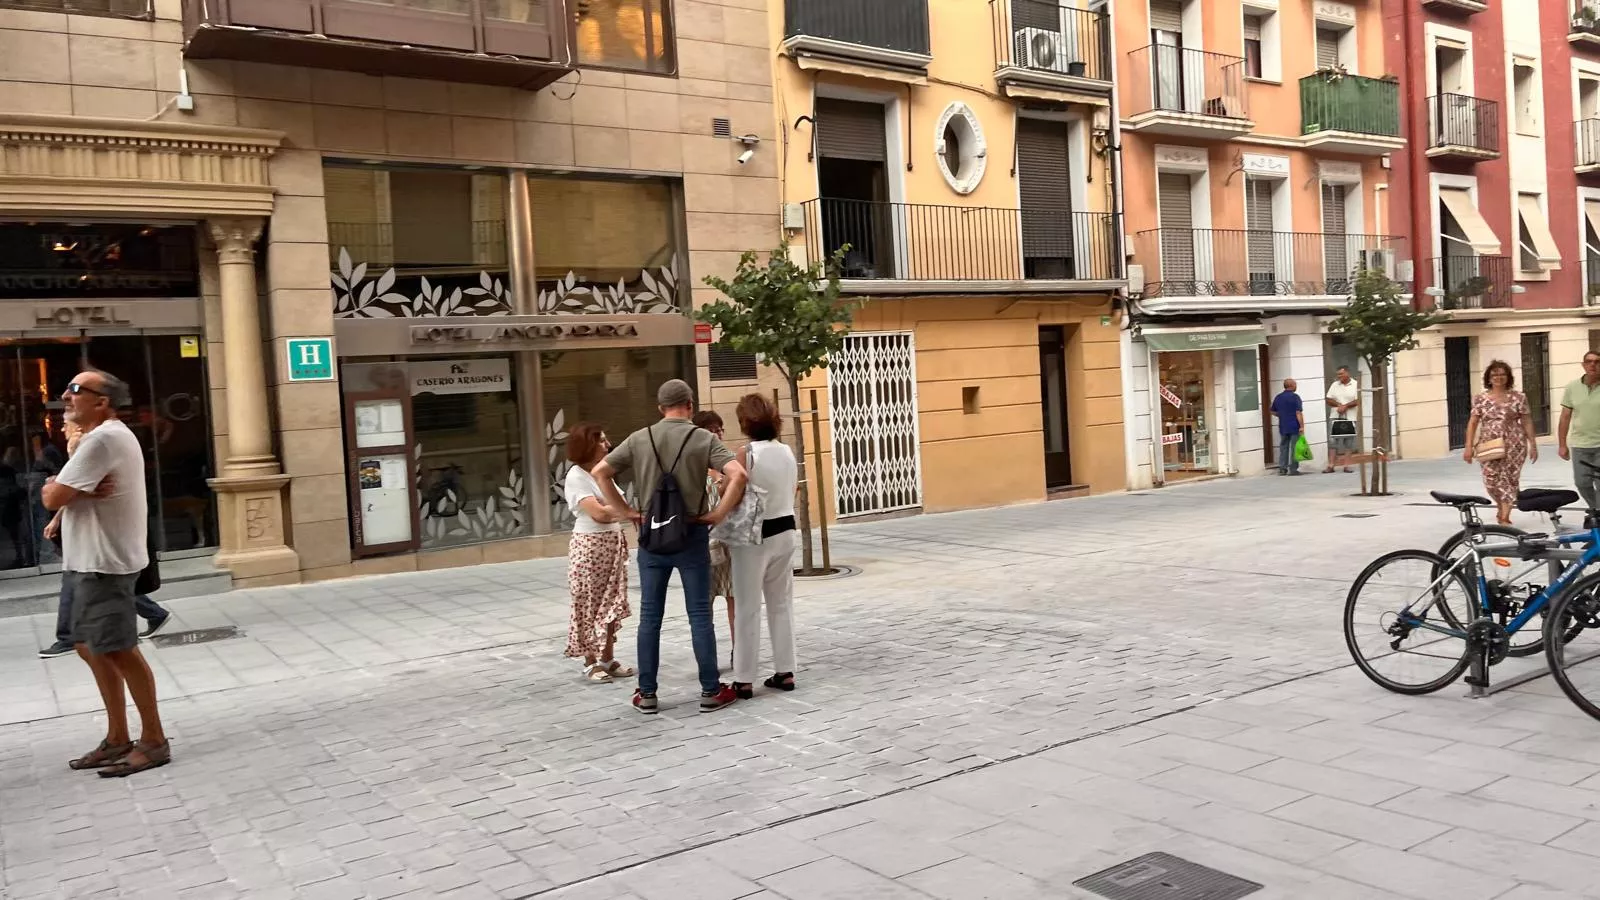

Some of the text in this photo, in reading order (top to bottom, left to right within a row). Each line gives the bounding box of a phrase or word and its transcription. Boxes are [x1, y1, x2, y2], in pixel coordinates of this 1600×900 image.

[35, 306, 130, 325] HOTEL
[411, 327, 482, 344] HOTEL
[298, 345, 321, 365] H
